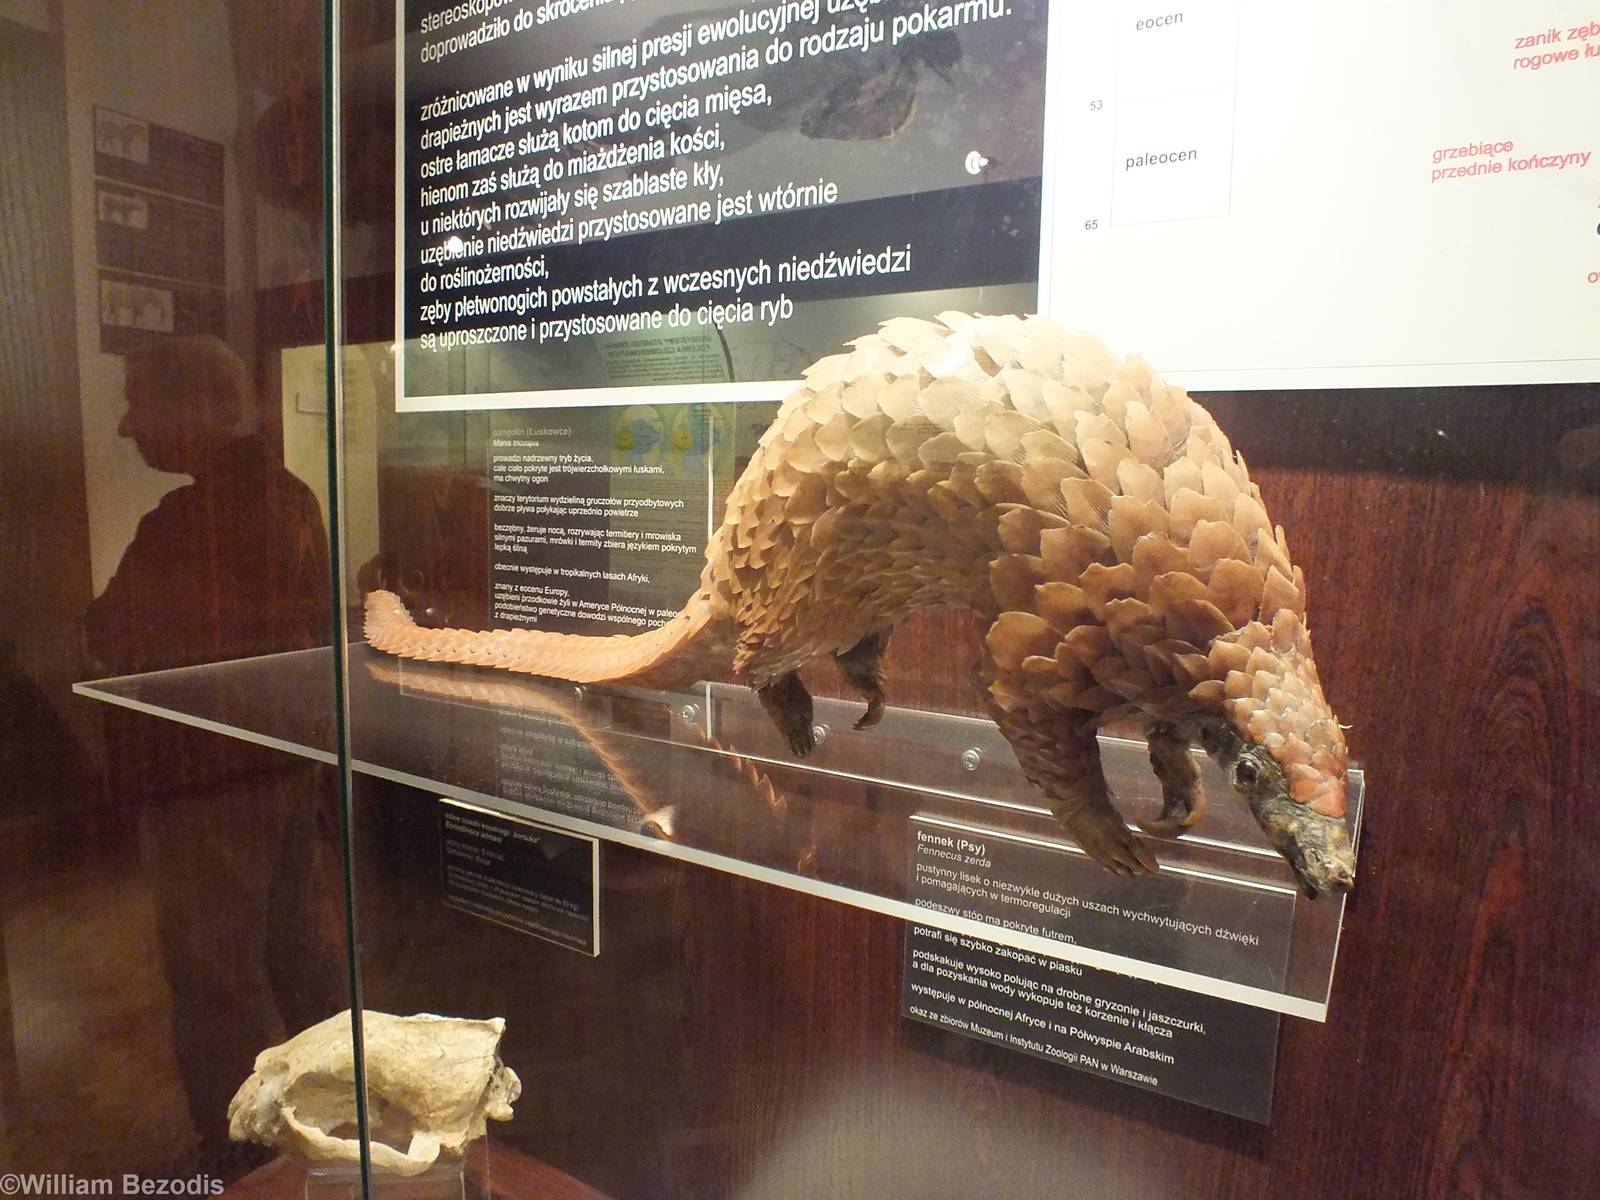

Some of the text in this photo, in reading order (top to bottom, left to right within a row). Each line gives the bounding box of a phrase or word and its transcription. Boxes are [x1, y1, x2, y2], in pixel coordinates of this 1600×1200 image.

[421, 8, 533, 63] doprowadziło do
[1136, 12, 1183, 31] eocen
[1514, 28, 1562, 49] zanik
[421, 0, 819, 121] zróżnicowane w wyniku silnej presji ewolucyjnej
[421, 0, 1012, 150] drapieżnych jest wyrazem przystosowania do rodzaju pokarmu.
[1513, 49, 1579, 70] rogowe
[421, 83, 772, 178] ostre łamacze służą kotom do cięcia mięsa,
[1090, 100, 1103, 111] 53
[421, 123, 725, 207] hienom zaś służą do miażdżenia kości,
[1125, 150, 1197, 171] paleocen
[1431, 150, 1591, 183] przednie kończyny
[1432, 140, 1514, 164] grzebiące
[421, 160, 724, 235] u niektórych rozwijały się szablaste kły,
[421, 178, 838, 266] uzębnie niedźwiedzi przystosowane jest wtórnie
[1085, 220, 1098, 230] 65
[420, 244, 911, 325] zęby płetwonogich powstałych z wczesnych niedźwiedzi
[421, 255, 549, 293] do roślinożerności,
[420, 293, 794, 352] są uproszczone i przystosowane do cięcia ryb
[917, 831, 986, 856] fennek (Psy)
[917, 844, 991, 868] Fennecus zerda
[915, 898, 961, 917] podeszwy
[963, 910, 983, 924] stóp
[985, 915, 1000, 925] ma
[1002, 919, 1039, 934] pokryte
[916, 863, 957, 879] pustynny
[960, 870, 981, 884] lisek
[993, 879, 1040, 898] niezwykle
[1043, 890, 1079, 907] dużych
[1082, 900, 1119, 916] uszach
[1123, 907, 1212, 936] wychwytujących
[921, 876, 987, 898] pomagających
[990, 892, 998, 900] w
[1000, 893, 1071, 919] termoregulacji
[914, 926, 1082, 976] potrafi się szybko zakopać w piasku
[912, 961, 1173, 1038] a dla pozyskania wody wykopuje też korzenie i kłącza
[913, 949, 1206, 1035] podskakuje wysoko polując na drobne gryzonie i jaszczurki,
[909, 1005, 1158, 1086] okaz ze zbiorów Muzeum i Instytutu Zoologii PAN w Warszawie
[911, 983, 1175, 1065] występuje w północnej Afryce i na Półwyspie Arabskim
